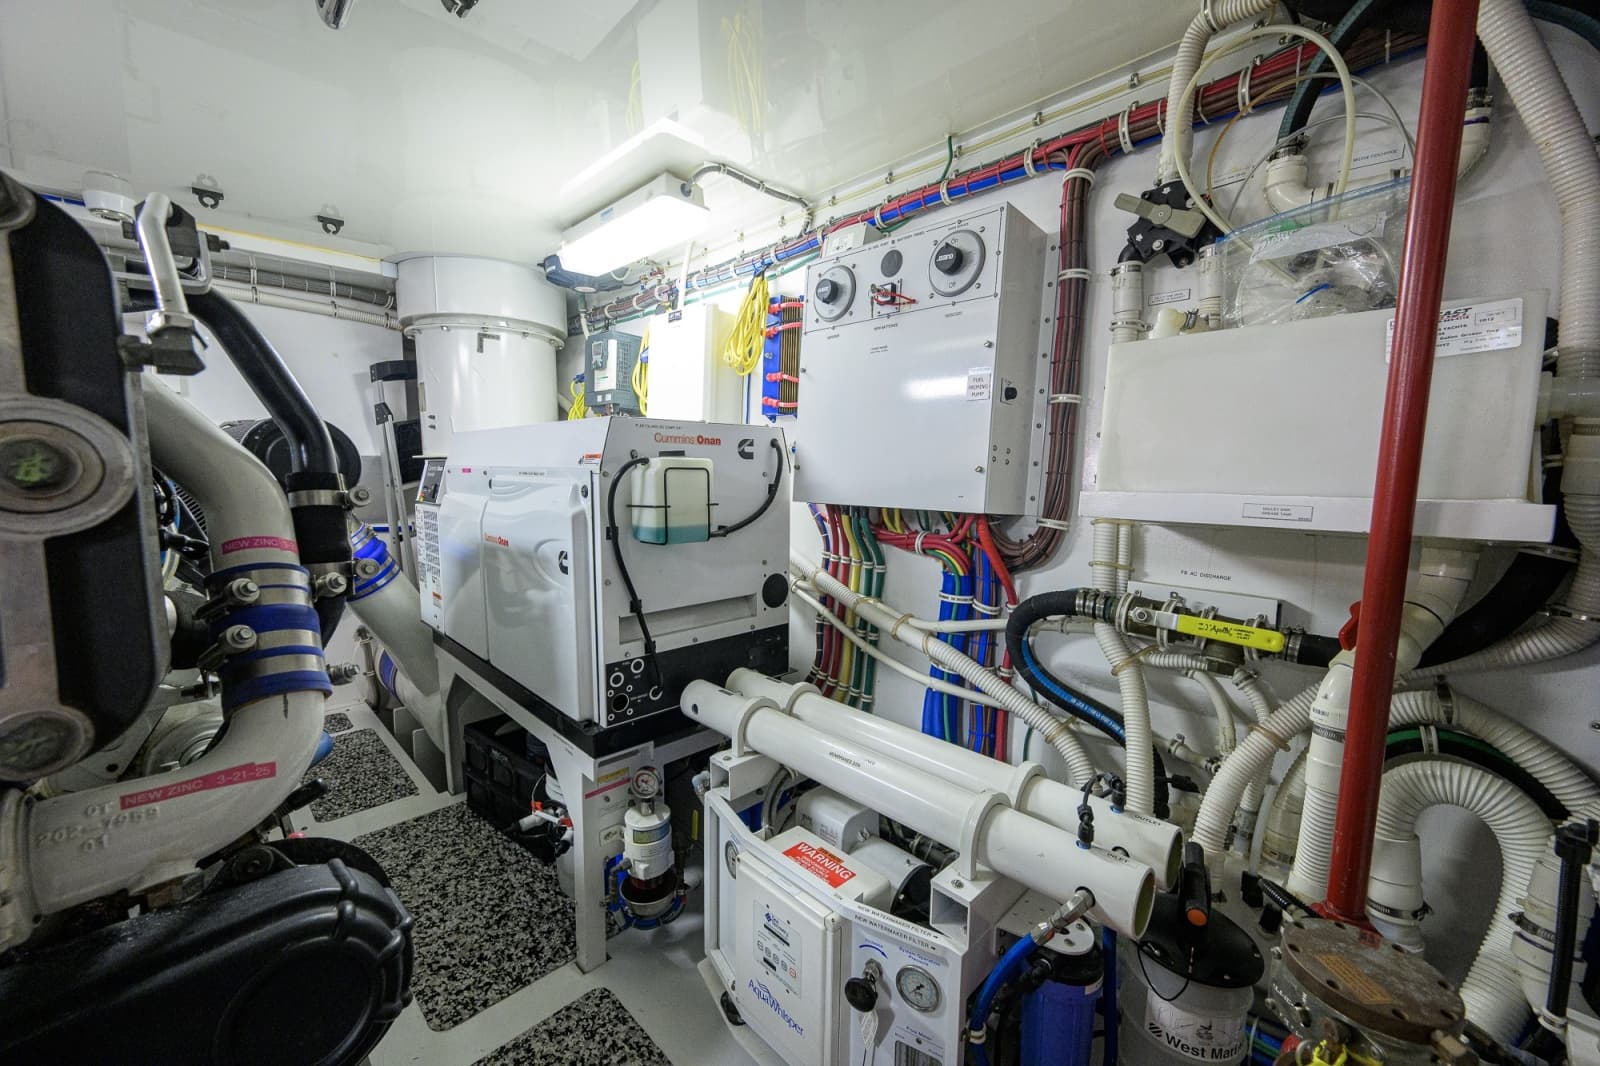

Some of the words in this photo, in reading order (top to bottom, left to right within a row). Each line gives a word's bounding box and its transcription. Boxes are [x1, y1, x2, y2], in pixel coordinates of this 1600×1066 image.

[654, 432, 695, 445] Cummins
[697, 435, 721, 446] Onan
[1200, 572, 1231, 581] DISCHARGE
[125, 790, 165, 807] NEW
[167, 780, 204, 797] ZINC
[216, 766, 272, 785] 3-21-25
[797, 843, 853, 879] WARNING
[854, 914, 868, 924] NEW
[868, 920, 909, 941] WATERMAKER
[908, 935, 930, 949] FILTER
[871, 911, 911, 929] WATERMAKER
[748, 978, 804, 1037] AquaWhisper
[1165, 1032, 1206, 1058] West
